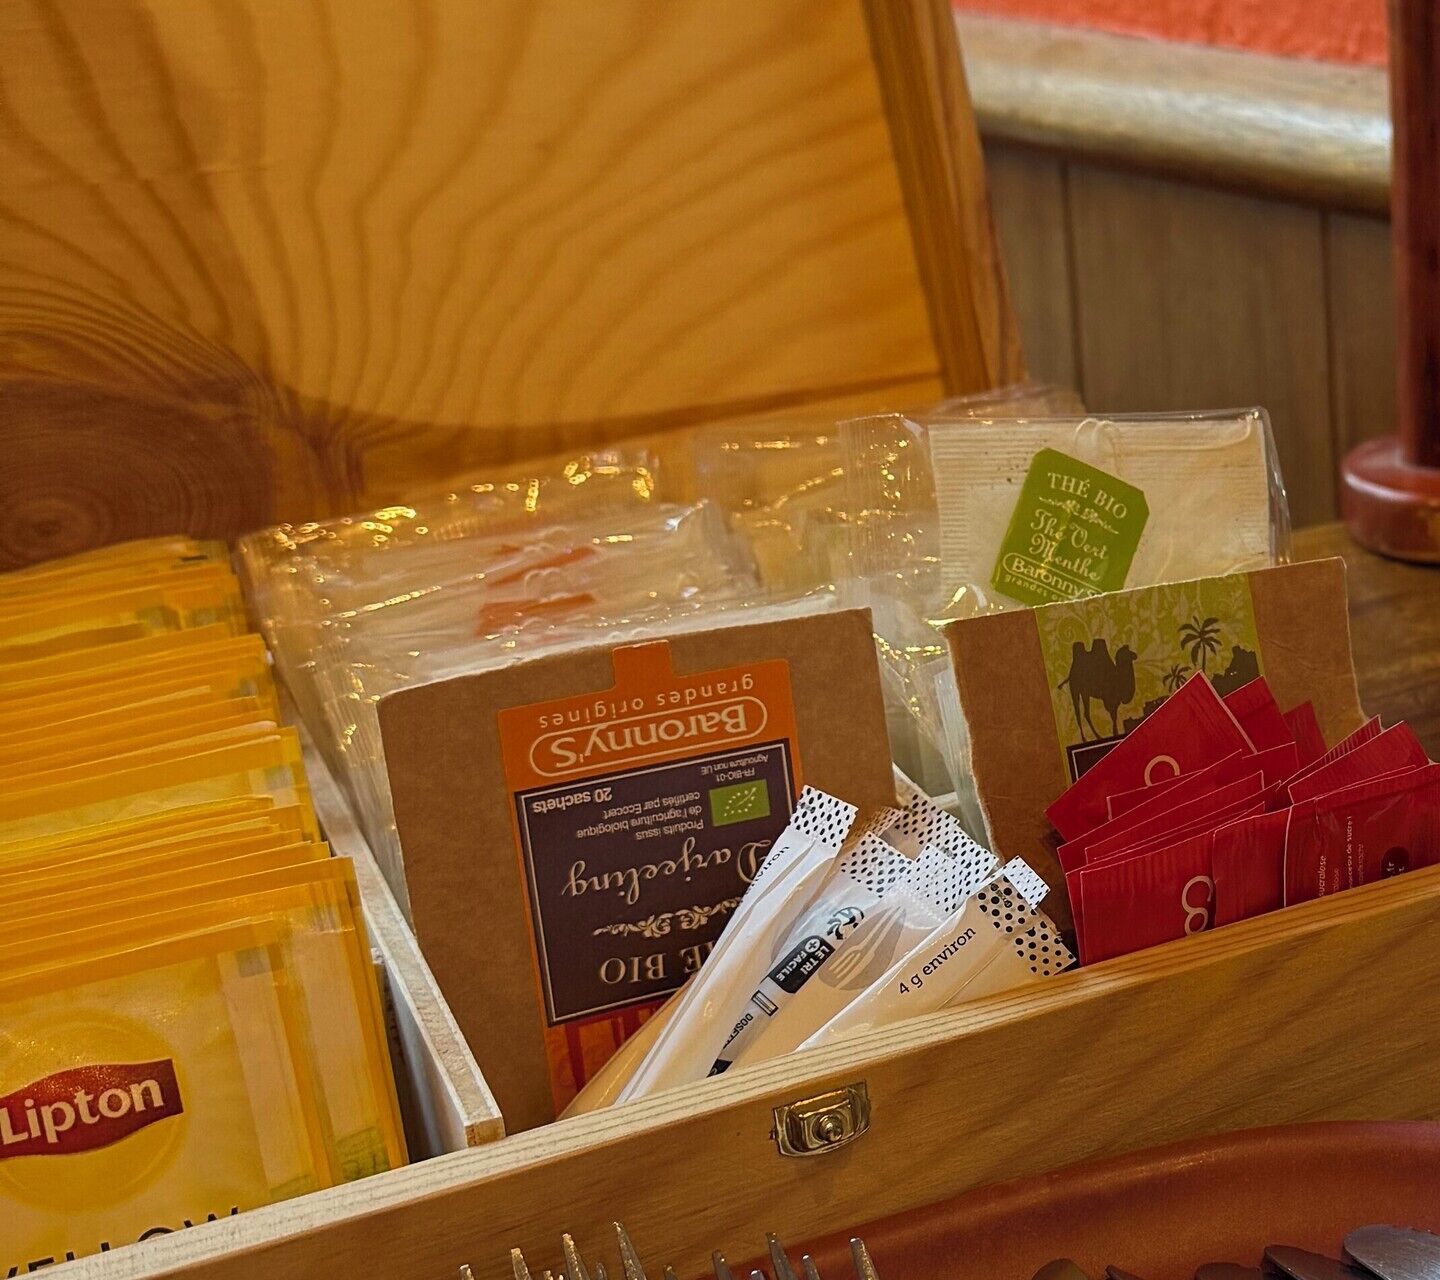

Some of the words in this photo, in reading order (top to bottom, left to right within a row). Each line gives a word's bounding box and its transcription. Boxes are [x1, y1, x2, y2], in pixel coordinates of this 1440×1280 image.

[1047, 472, 1090, 499] THÉ
[1094, 489, 1127, 519] BIO
[1030, 508, 1066, 540] Thé
[1069, 522, 1109, 559] Vert
[1028, 533, 1101, 582] Menthe
[1004, 573, 1047, 597] grandes
[657, 674, 754, 707] grandes
[539, 697, 644, 730] origines
[550, 703, 748, 769] Baronny'S
[701, 765, 713, 776] UE
[716, 767, 756, 783] FR-BIO-01
[533, 790, 592, 814] sachets
[594, 787, 613, 803] 20
[643, 796, 661, 811] par
[662, 791, 701, 806] certifiés
[603, 802, 642, 820] Ecocert
[631, 806, 688, 828] l'agriculture
[688, 805, 703, 816] de
[576, 818, 629, 839] biologique
[635, 827, 660, 841] issus
[662, 818, 704, 835] Produits
[561, 836, 772, 906] Darjeeling
[815, 942, 831, 959] LE
[898, 982, 911, 995] 4
[911, 972, 924, 989] g
[922, 926, 977, 976] environ
[600, 952, 667, 985] BIO
[775, 950, 806, 983] FACILE
[799, 955, 819, 978] TRI
[0, 1079, 165, 1145] Lipton
